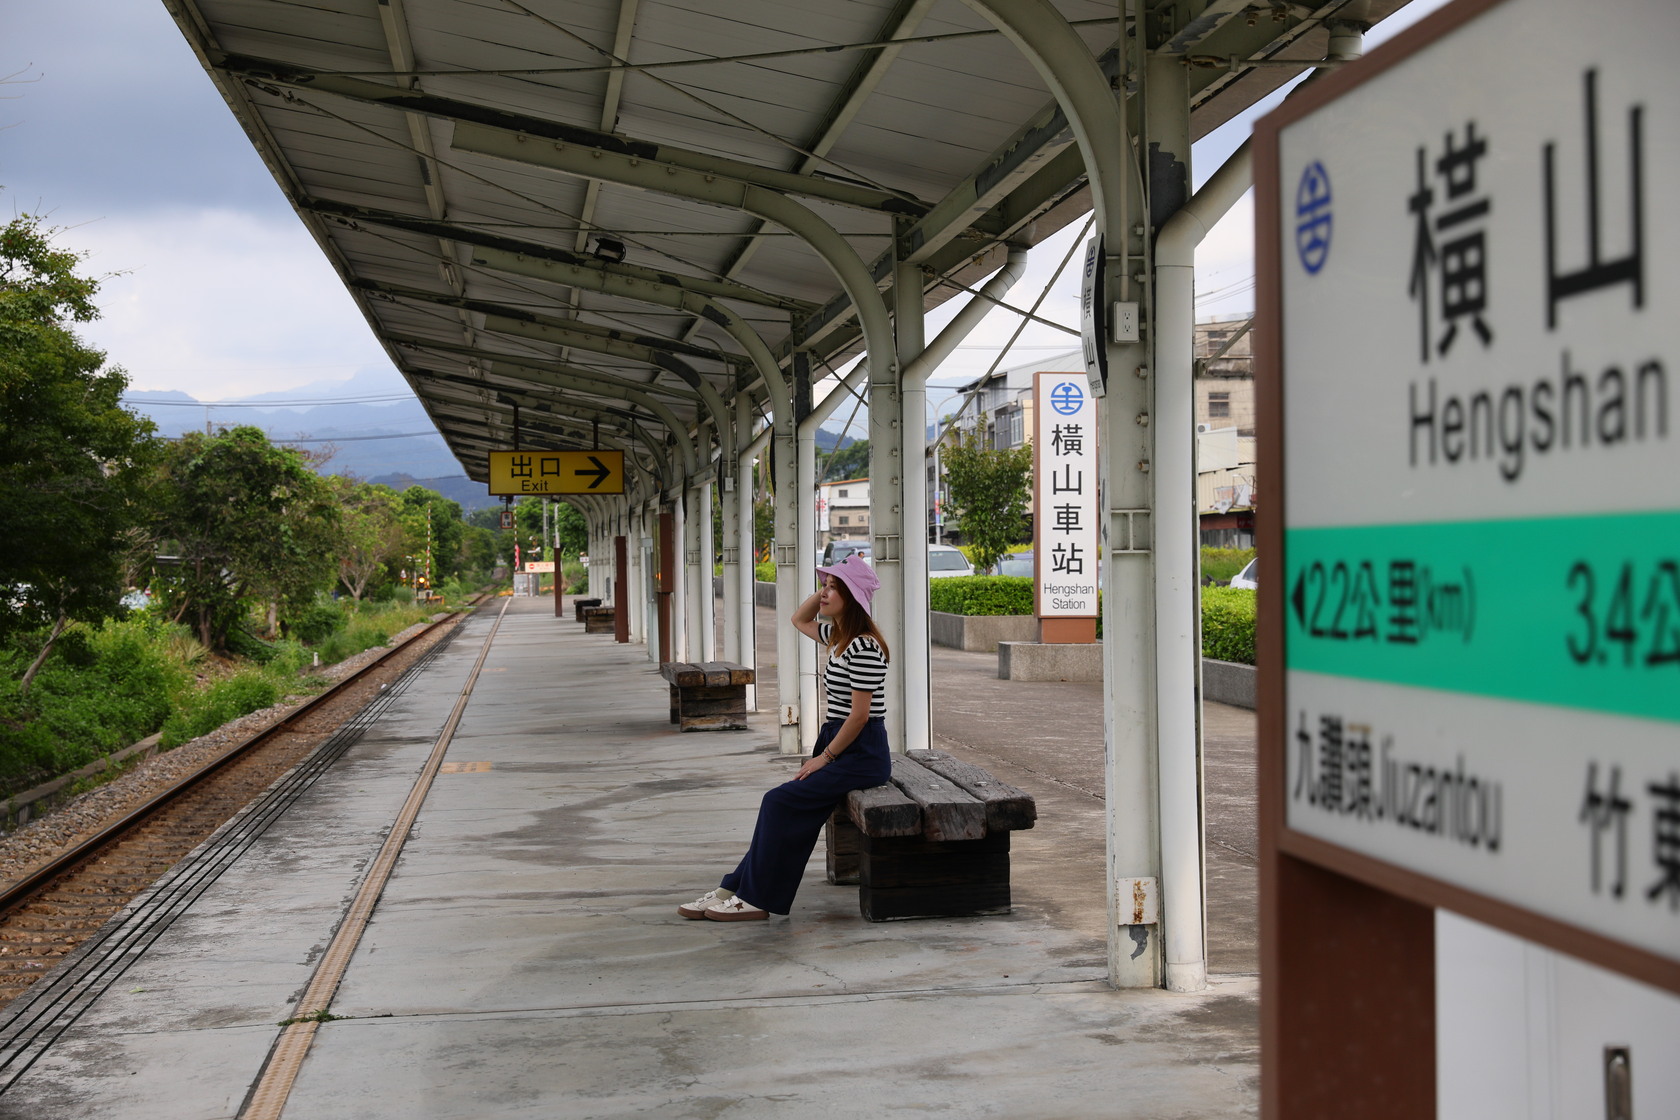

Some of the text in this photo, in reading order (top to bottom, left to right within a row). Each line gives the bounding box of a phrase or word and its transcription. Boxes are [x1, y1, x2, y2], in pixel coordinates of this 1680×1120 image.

[1407, 66, 1644, 365] 橫山
[1409, 348, 1668, 481] Hengshan
[511, 455, 560, 478] 出口
[521, 480, 549, 492] Exit
[1051, 423, 1084, 575] 橫山車站
[1043, 583, 1094, 600] Hengshan
[1052, 598, 1086, 610] Station
